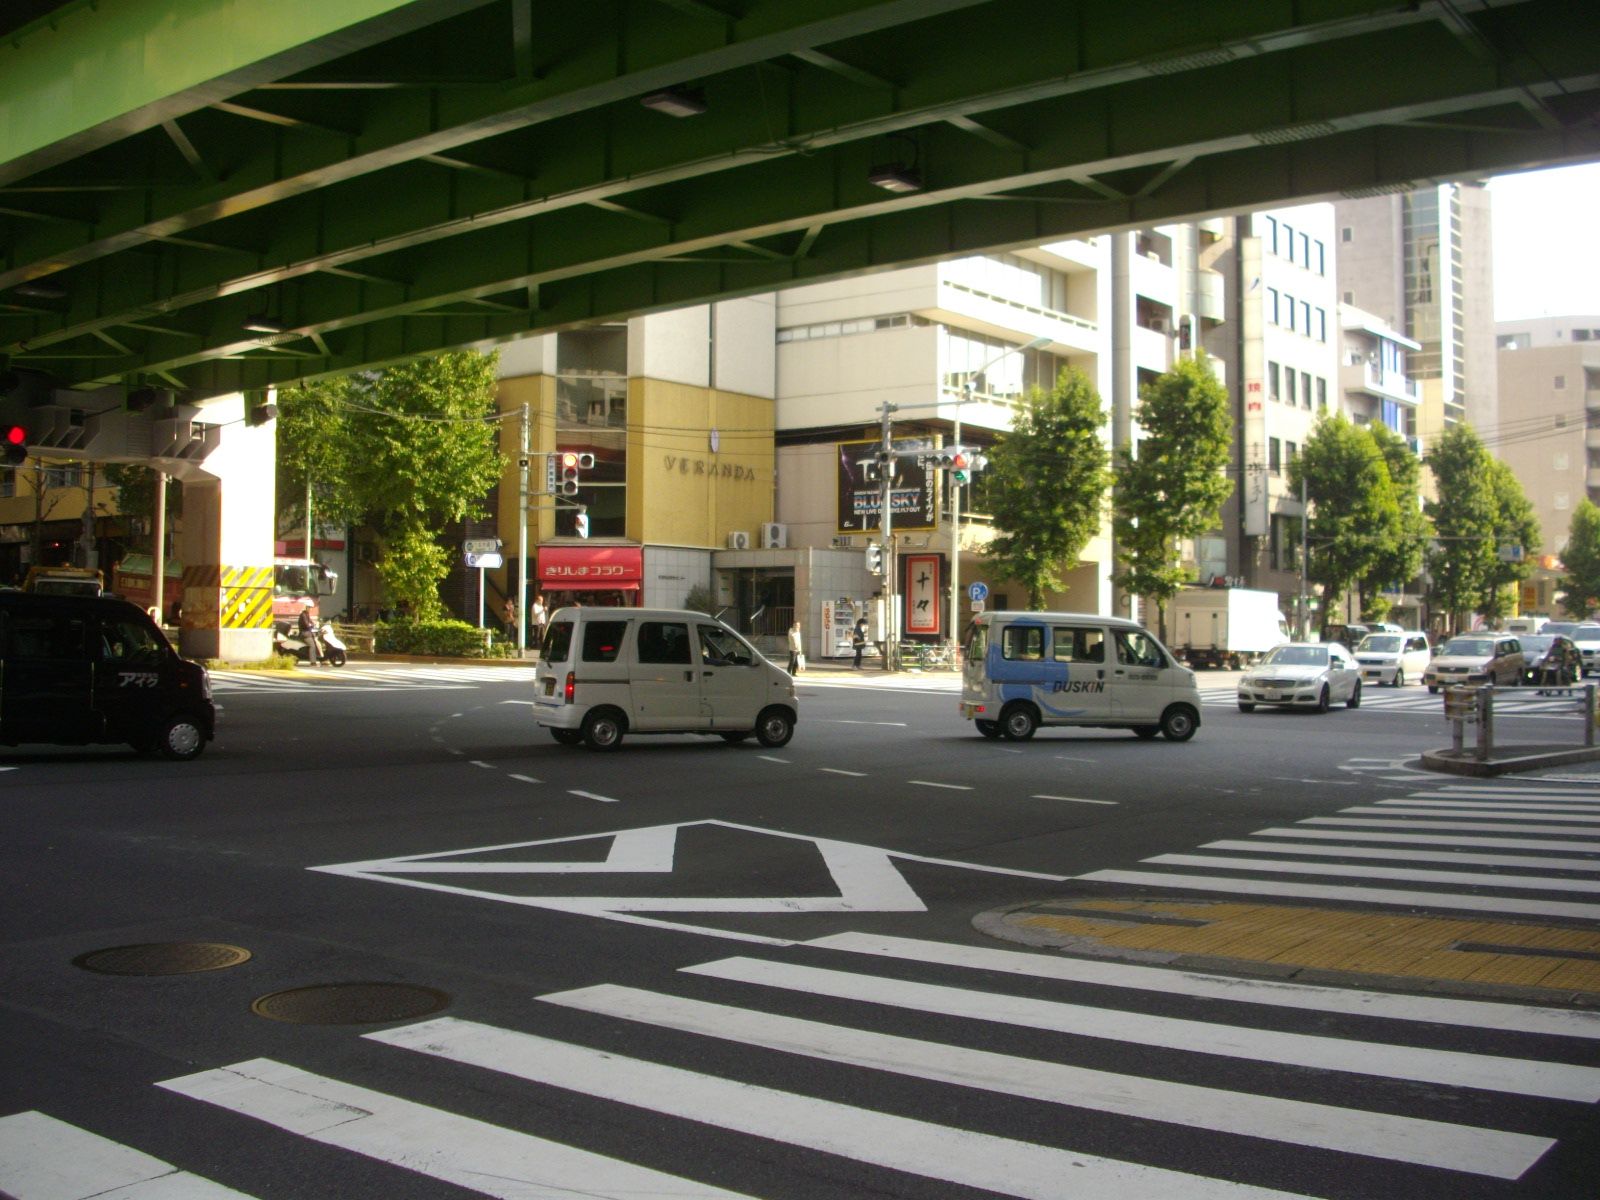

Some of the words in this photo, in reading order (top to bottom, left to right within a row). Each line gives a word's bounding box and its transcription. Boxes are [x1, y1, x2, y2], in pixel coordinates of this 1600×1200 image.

[663, 455, 755, 481] VERANDA
[854, 494, 888, 509] BLU
[891, 491, 920, 507] SKY
[972, 587, 981, 600] P
[1053, 681, 1104, 693] DUSKIN
